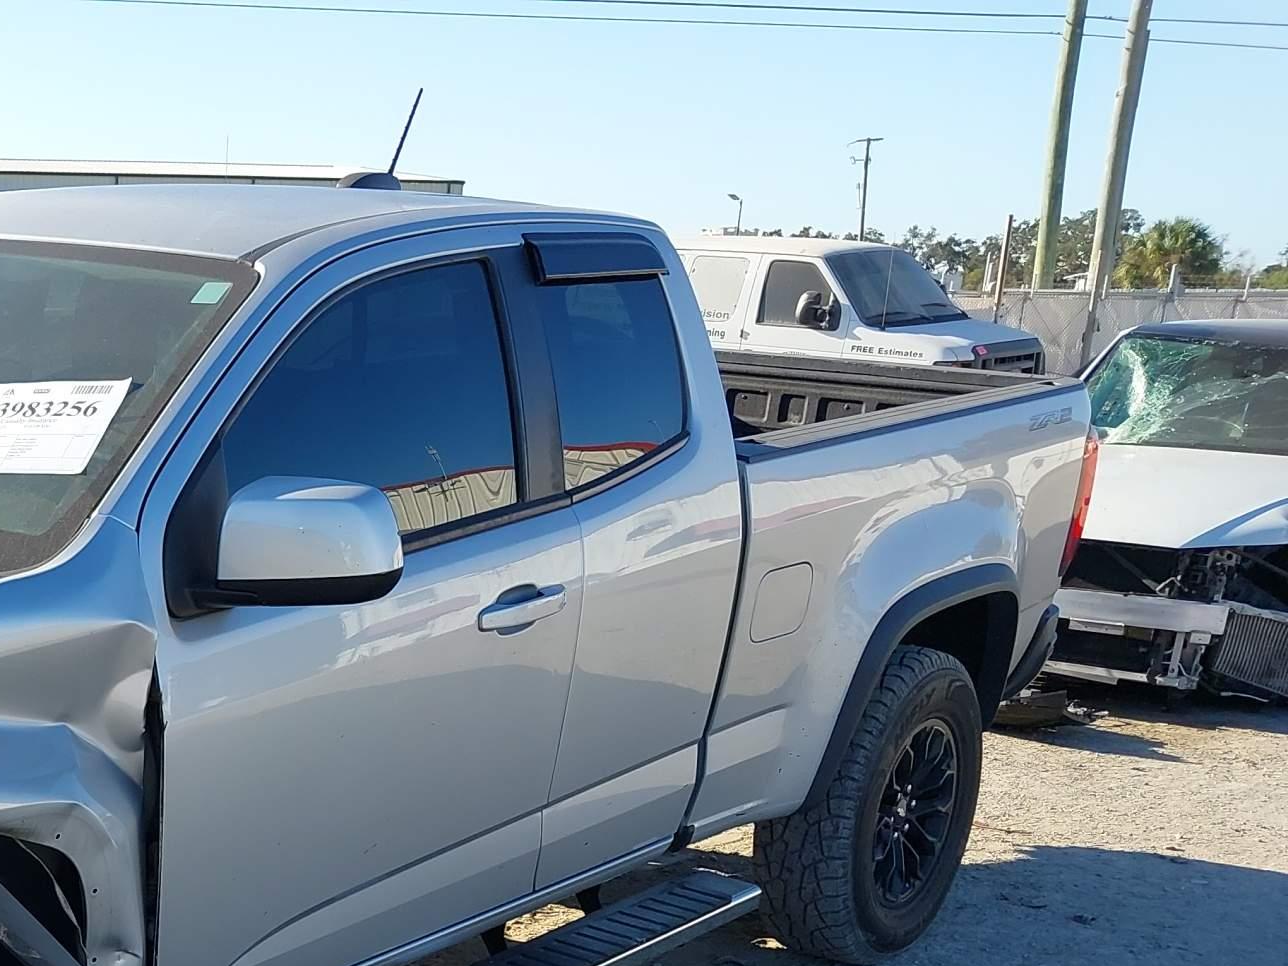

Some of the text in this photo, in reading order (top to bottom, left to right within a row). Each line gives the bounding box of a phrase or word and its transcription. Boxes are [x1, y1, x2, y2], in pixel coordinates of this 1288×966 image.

[850, 344, 924, 359] FREE Estimates
[1029, 406, 1073, 432] ZR2
